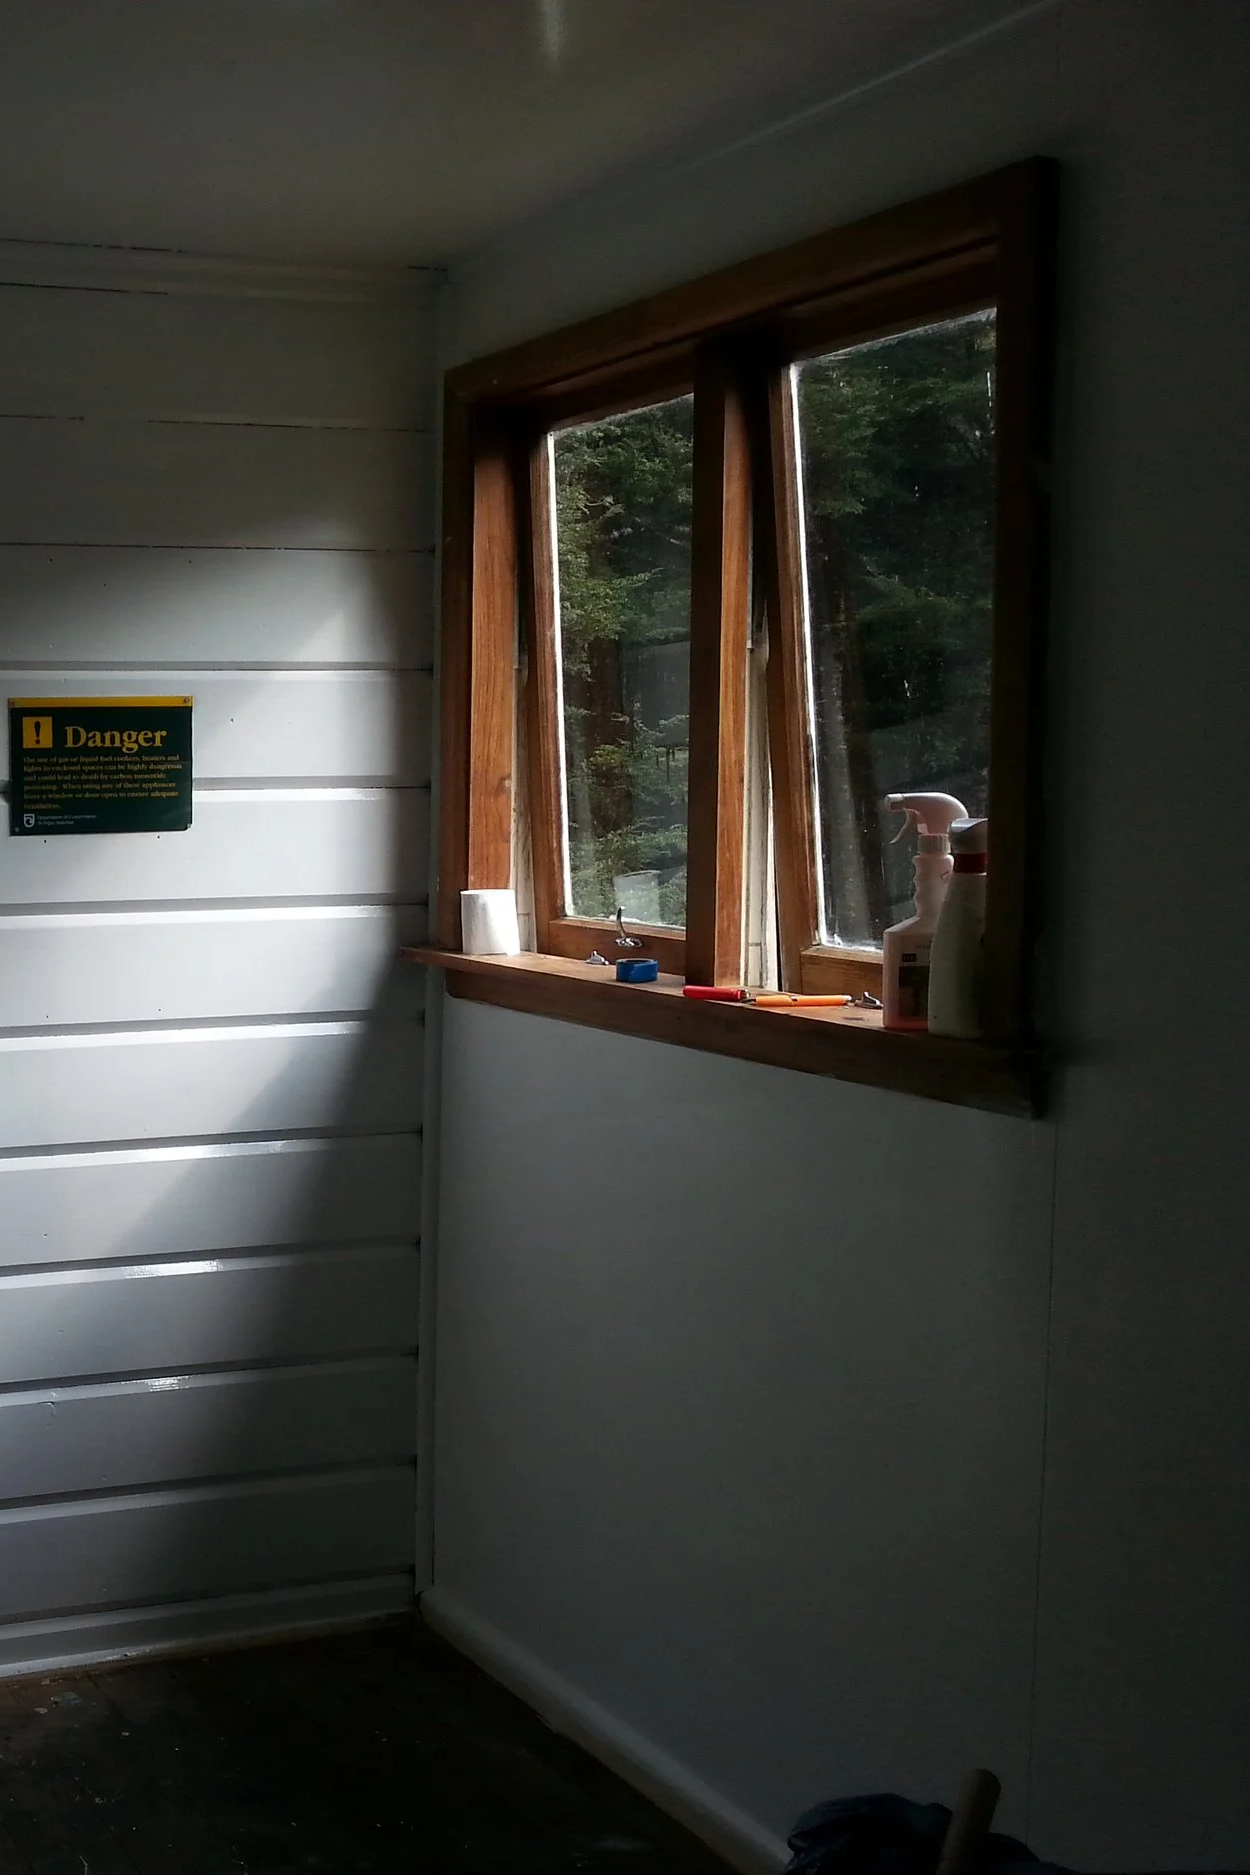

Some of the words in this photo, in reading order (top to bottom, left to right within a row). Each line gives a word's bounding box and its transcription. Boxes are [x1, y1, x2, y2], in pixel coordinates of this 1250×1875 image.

[64, 725, 168, 753] Danger
[100, 755, 112, 763] fuel
[127, 763, 147, 772] highly
[149, 762, 182, 771] dangerous
[100, 773, 109, 781] by
